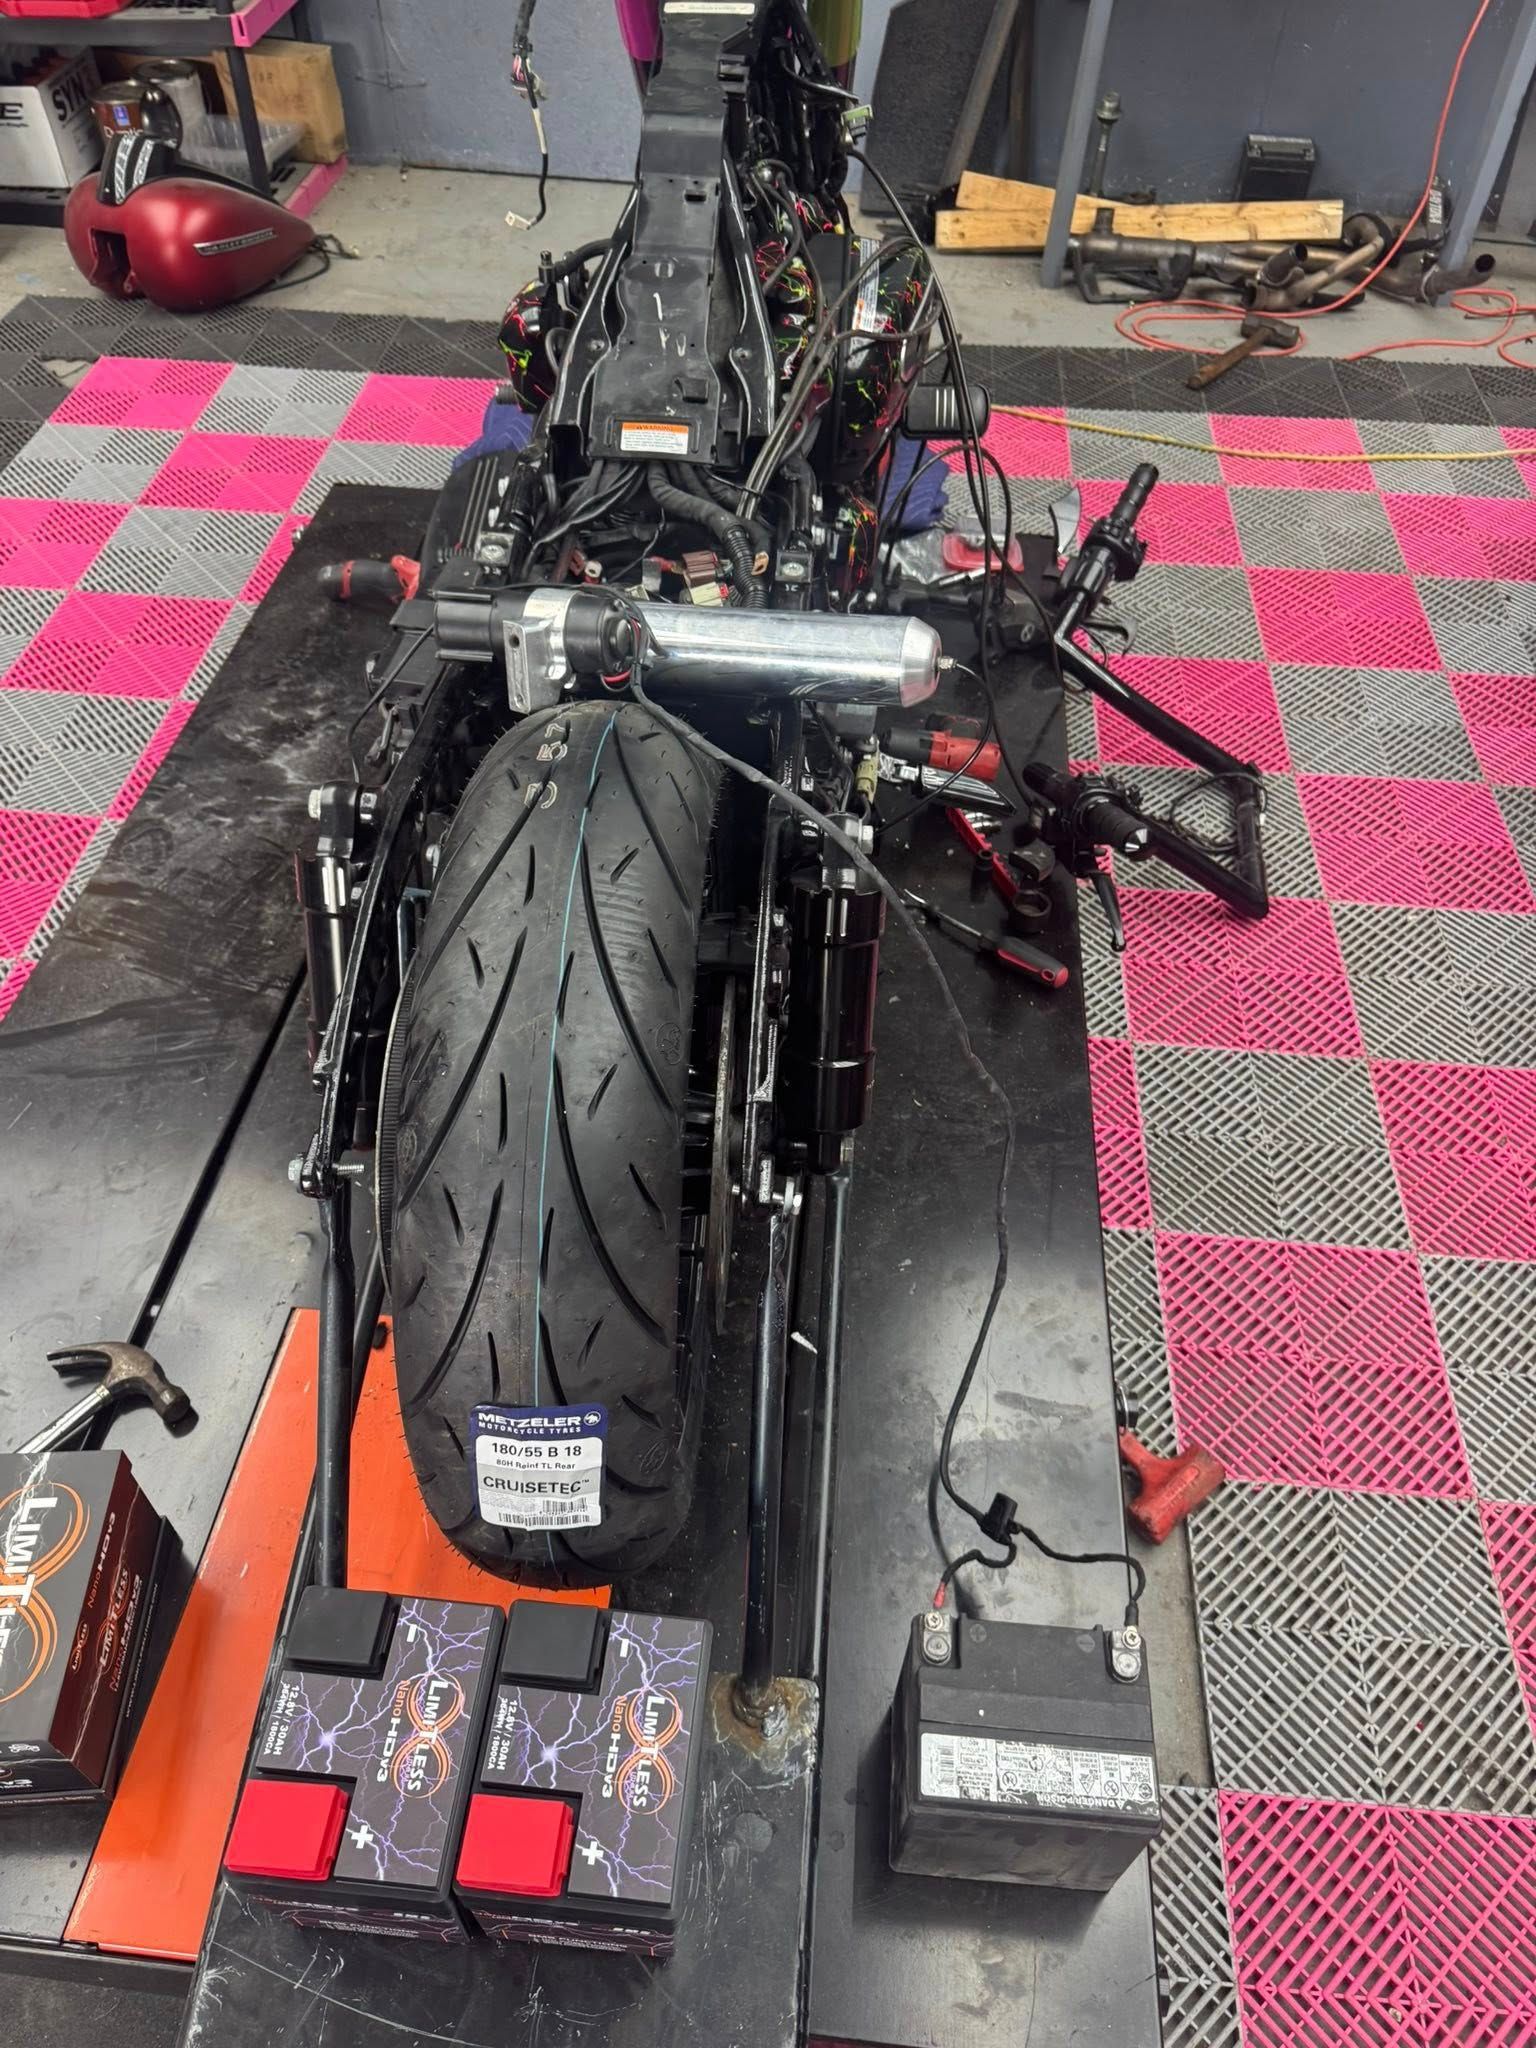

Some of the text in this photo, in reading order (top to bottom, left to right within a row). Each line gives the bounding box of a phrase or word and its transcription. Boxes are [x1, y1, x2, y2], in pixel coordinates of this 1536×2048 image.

[478, 1412, 581, 1428] METZELER
[479, 1421, 581, 1434] MOTORCYCLE TYRES
[492, 1442, 582, 1458] 180/55 B 18
[516, 1461, 538, 1469] Reinf
[287, 1685, 300, 1717] 12.8V
[507, 1700, 518, 1732] 12.8V
[273, 1723, 289, 1756] 30AH
[377, 1680, 411, 1783] NanoHDv3
[408, 1681, 449, 1791] LIMITLESS
[602, 1695, 628, 1798] NanoHDv3
[497, 1738, 511, 1771] 30AH
[632, 1695, 665, 1808] LIMITLESS
